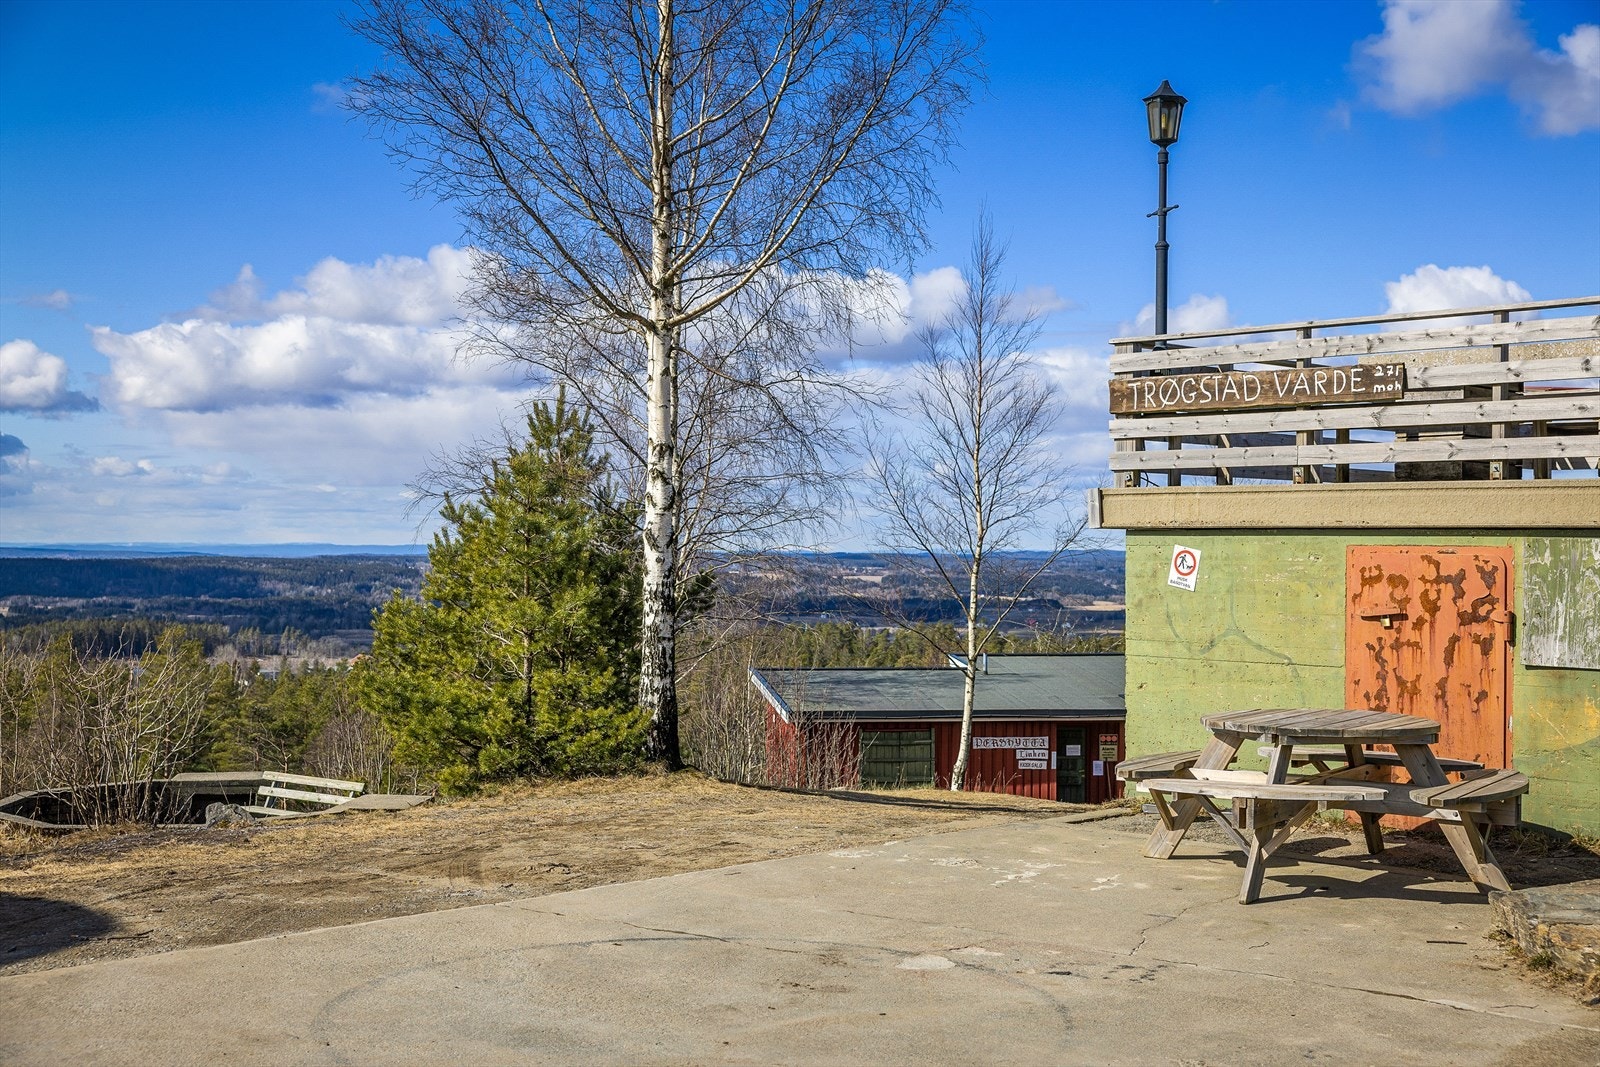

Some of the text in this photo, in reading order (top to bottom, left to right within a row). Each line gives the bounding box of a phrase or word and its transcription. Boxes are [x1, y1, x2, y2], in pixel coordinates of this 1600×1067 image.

[1374, 365, 1399, 377] 271
[1128, 369, 1366, 409] TRØGSTAD VARDE
